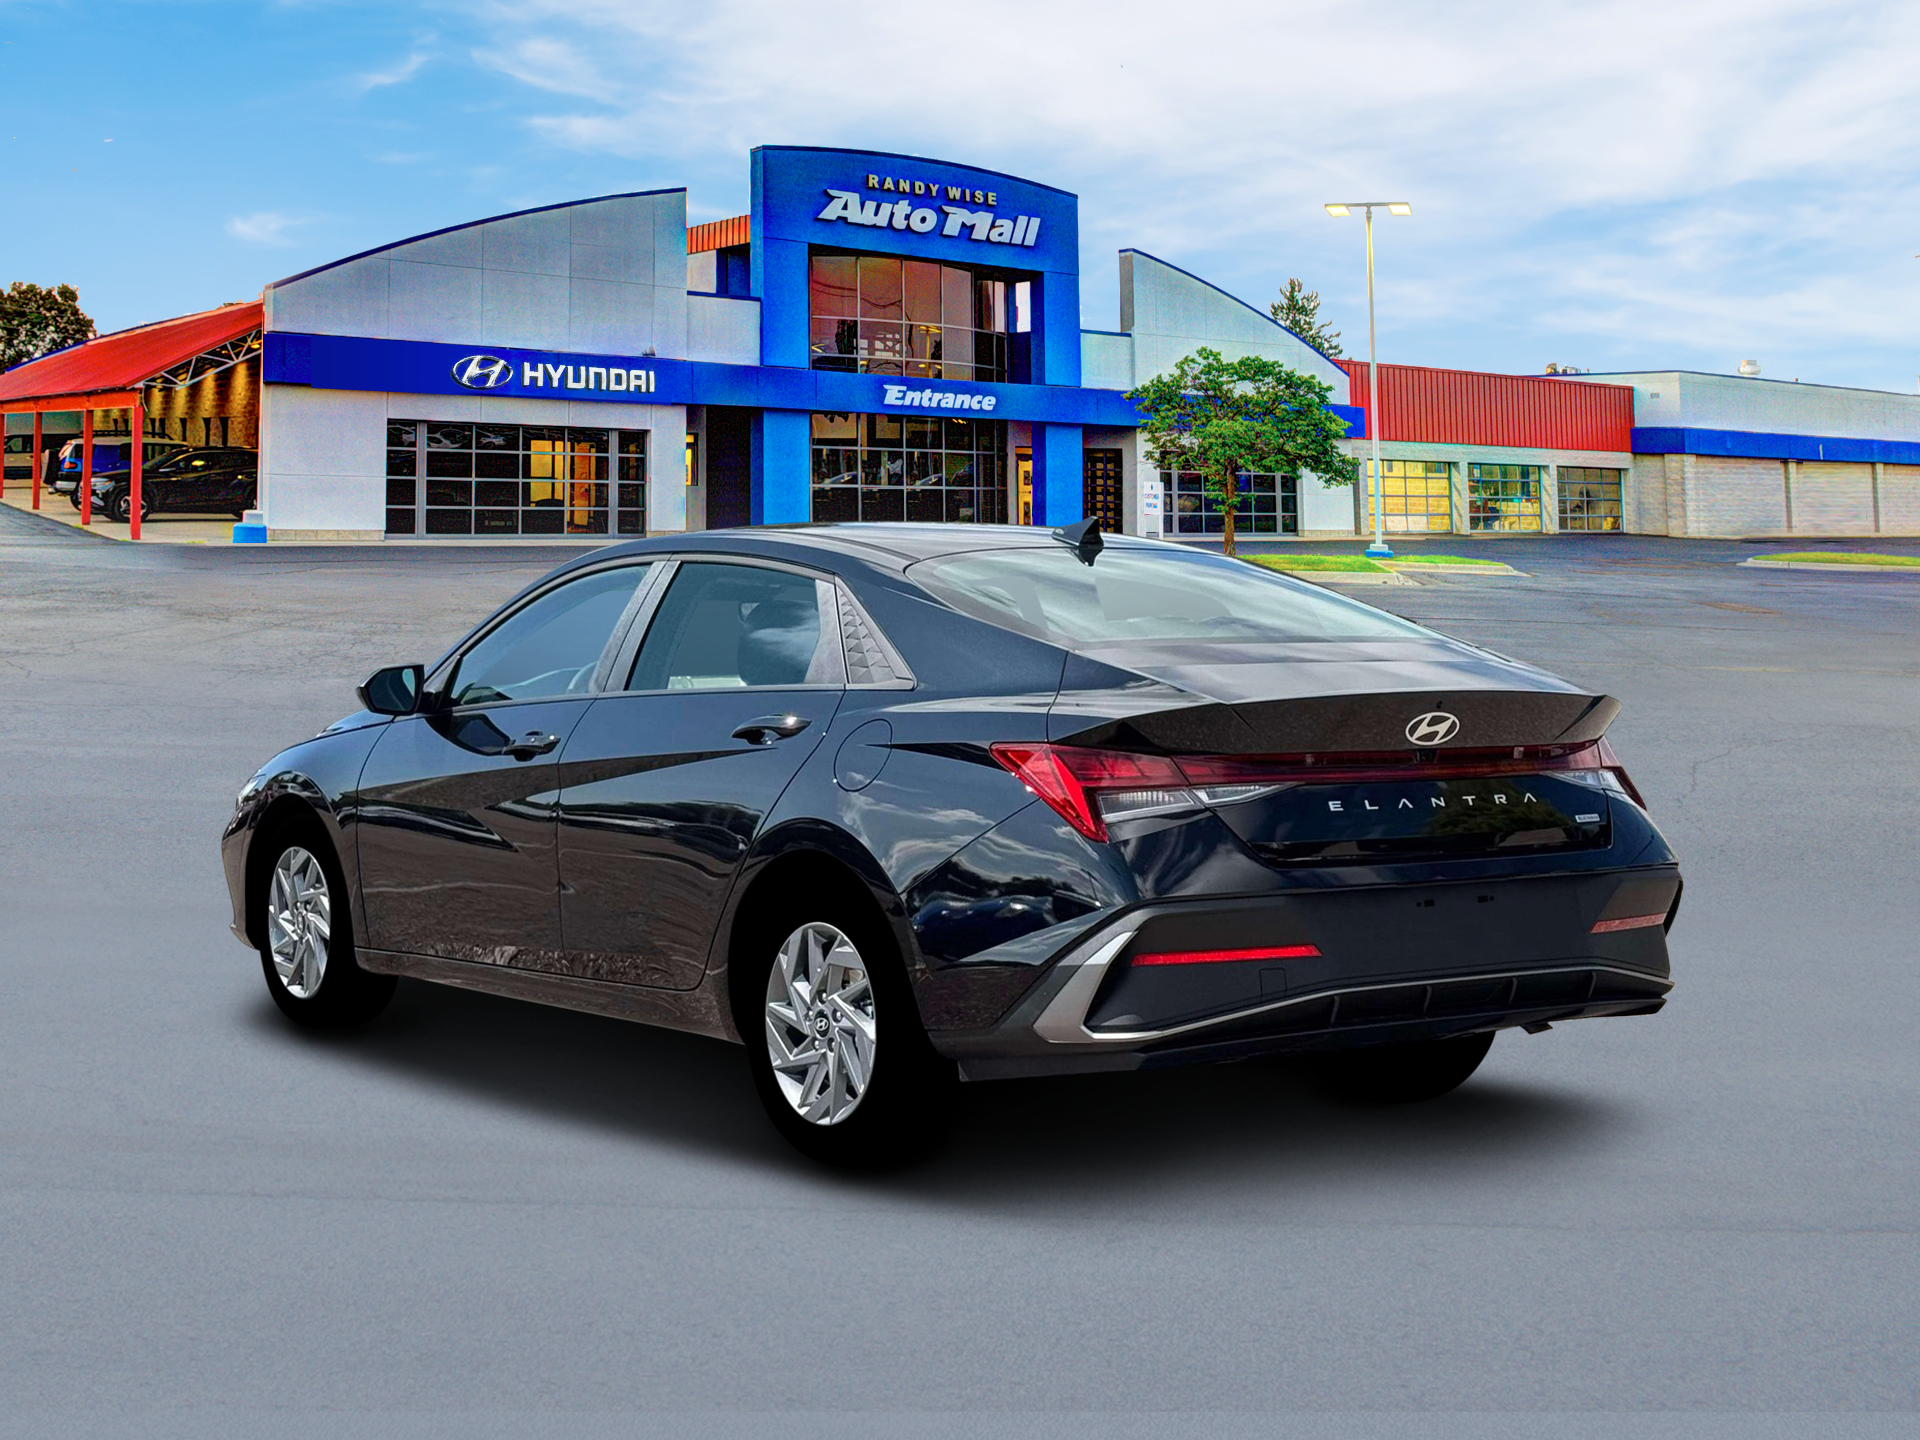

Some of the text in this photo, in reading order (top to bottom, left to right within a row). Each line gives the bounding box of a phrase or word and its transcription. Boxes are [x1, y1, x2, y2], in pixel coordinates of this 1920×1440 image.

[867, 174, 997, 205] RANDY WISE
[817, 189, 1041, 247] Auto Mall
[522, 362, 656, 393] HYUNDAI
[883, 384, 997, 411] Entrance
[1328, 792, 1538, 811] ELANTRA
